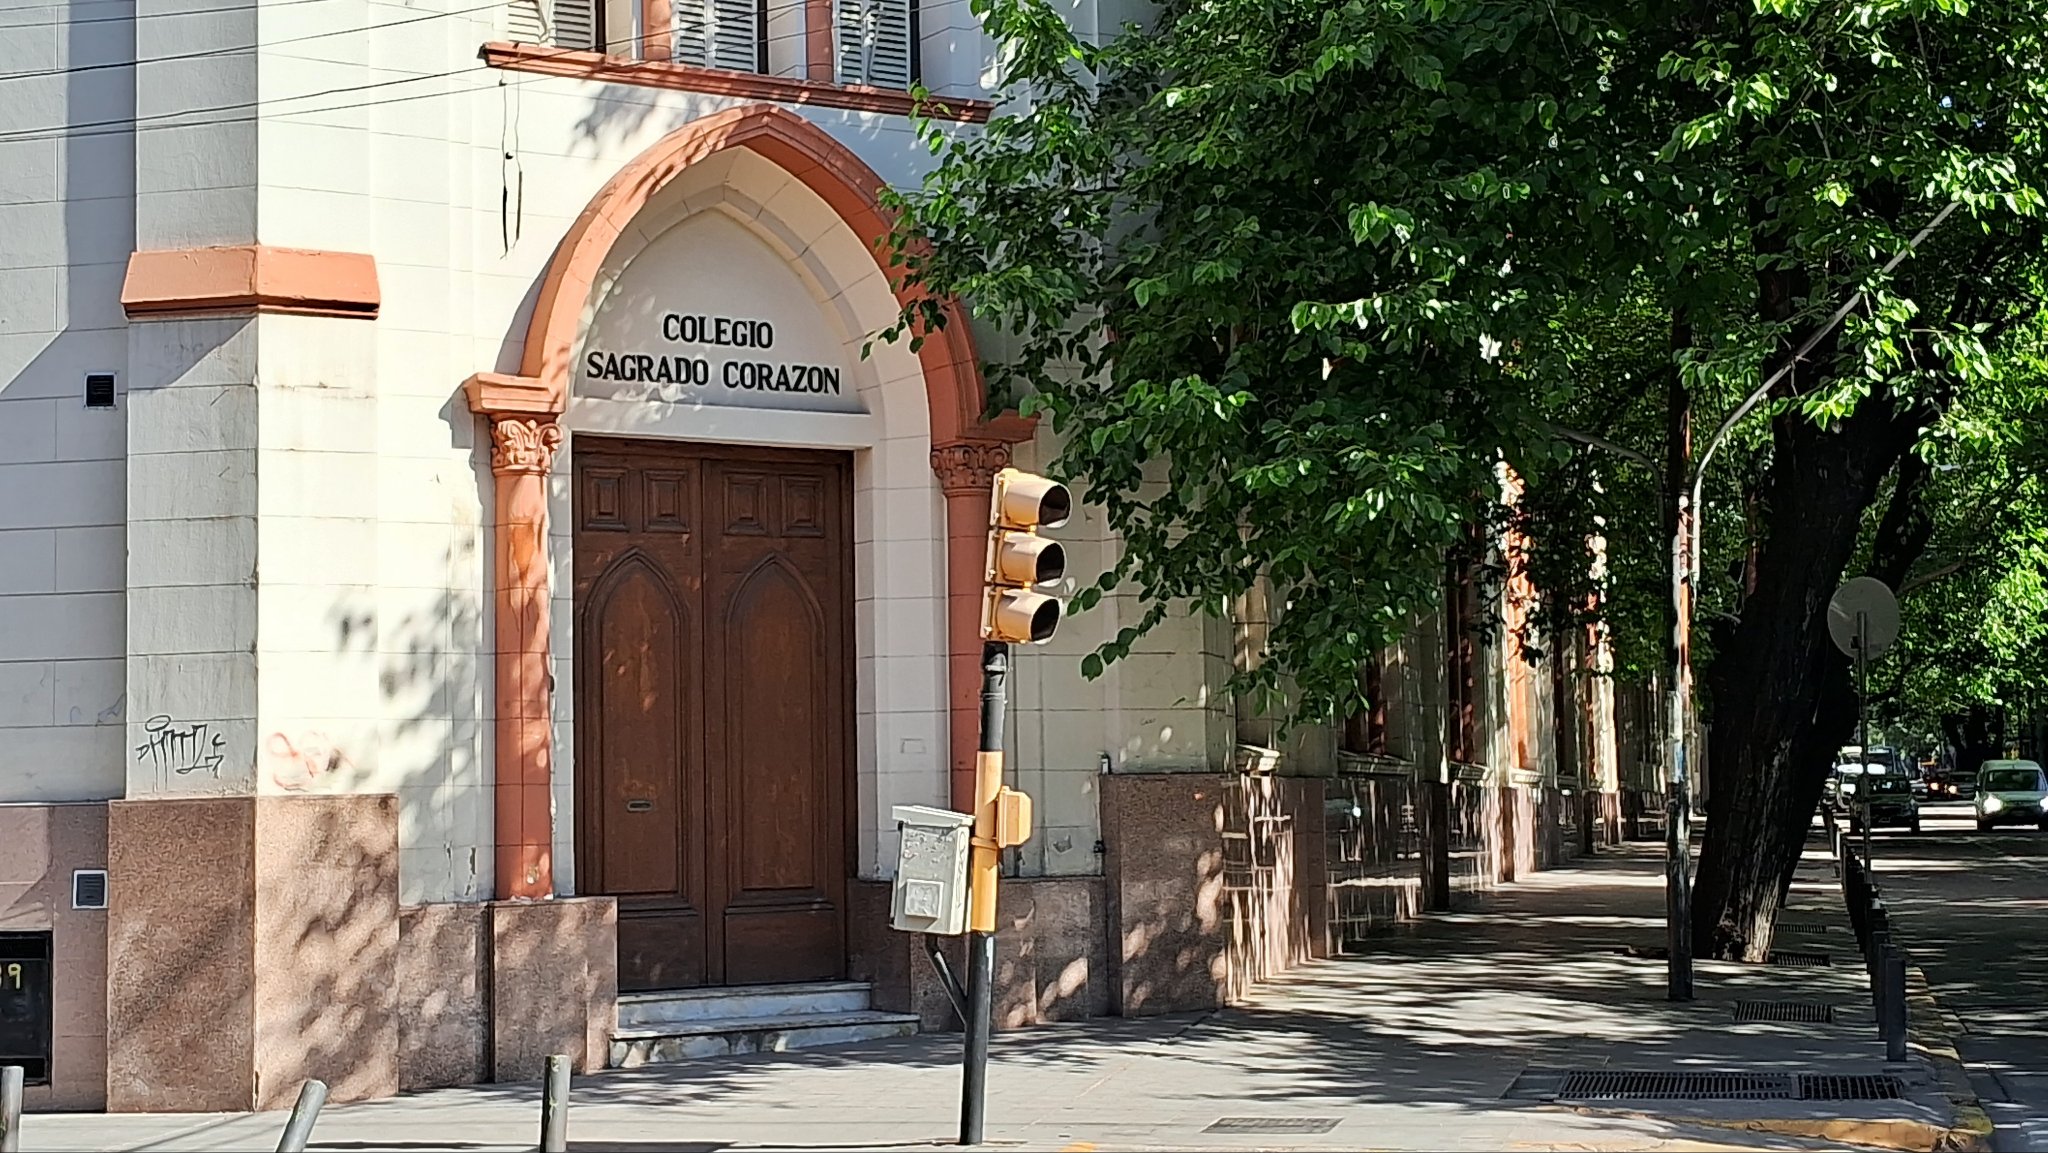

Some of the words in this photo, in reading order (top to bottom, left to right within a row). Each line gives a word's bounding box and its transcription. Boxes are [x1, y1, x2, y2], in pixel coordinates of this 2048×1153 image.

[663, 313, 774, 349] COLEGIO
[586, 351, 709, 386] SAGRADO
[722, 360, 840, 395] CORAZON
